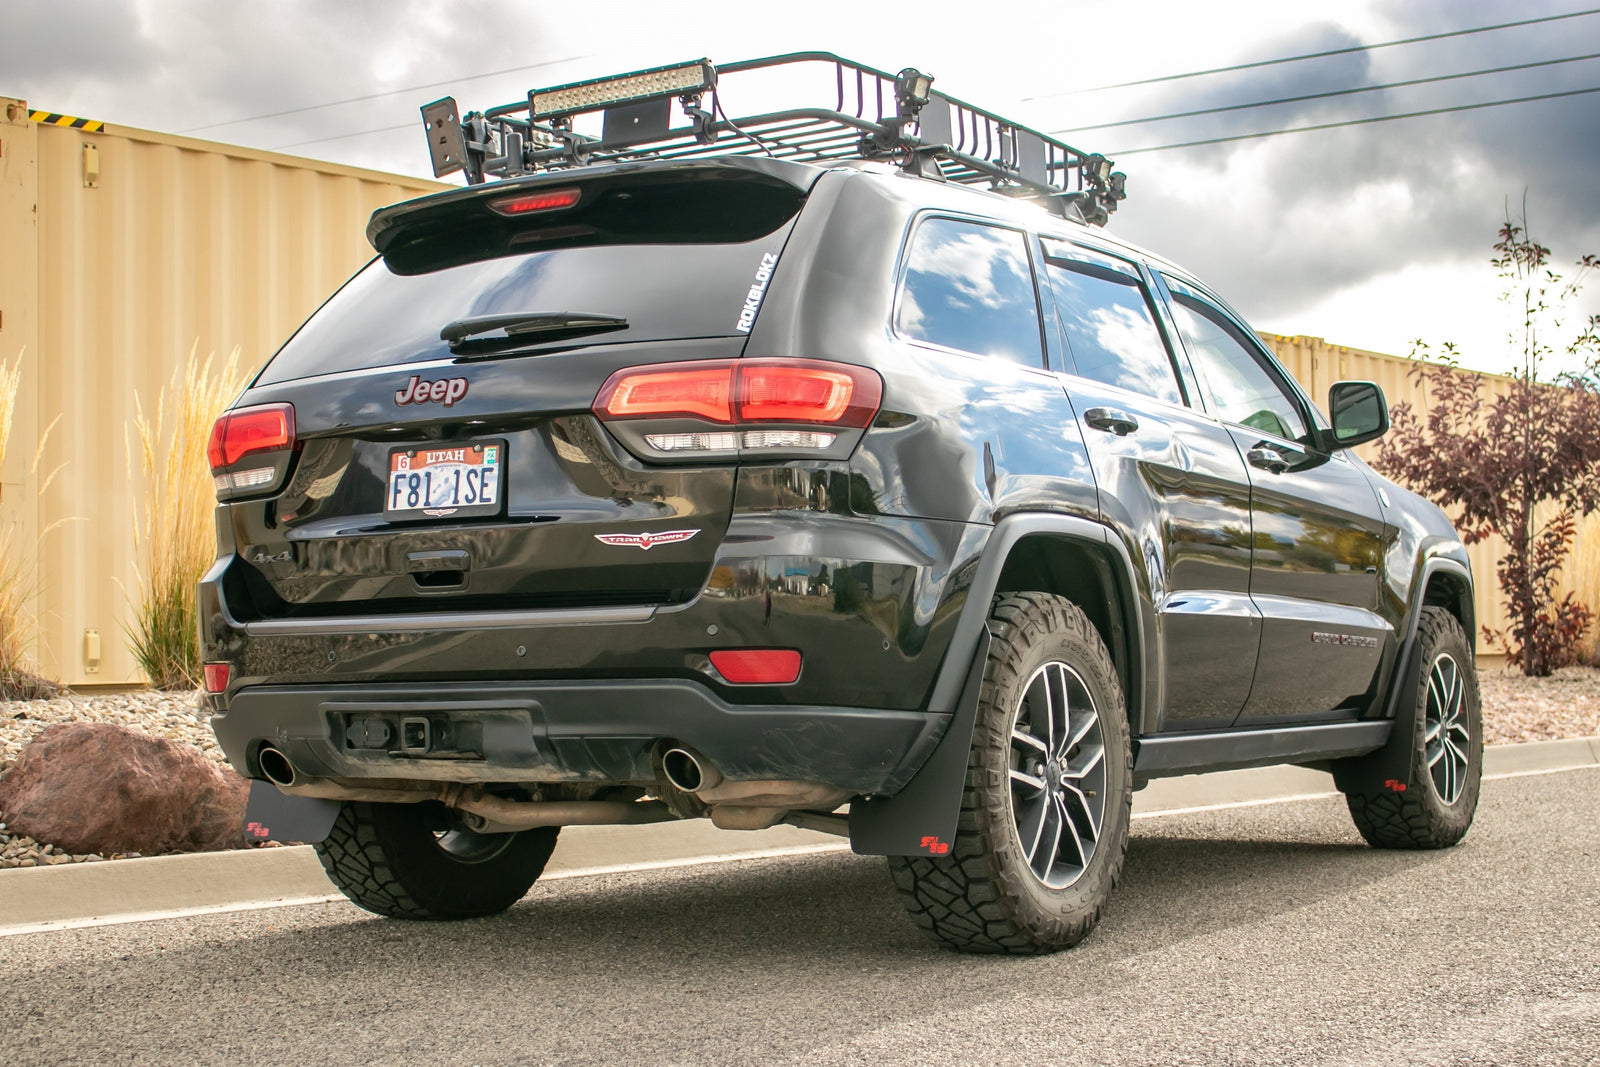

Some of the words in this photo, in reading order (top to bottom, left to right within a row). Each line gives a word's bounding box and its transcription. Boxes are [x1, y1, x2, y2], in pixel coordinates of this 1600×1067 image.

[394, 376, 469, 407] Jeep
[400, 457, 408, 469] 6
[425, 449, 465, 464] UTAH
[393, 472, 431, 508] F81
[452, 467, 494, 504] 1SE
